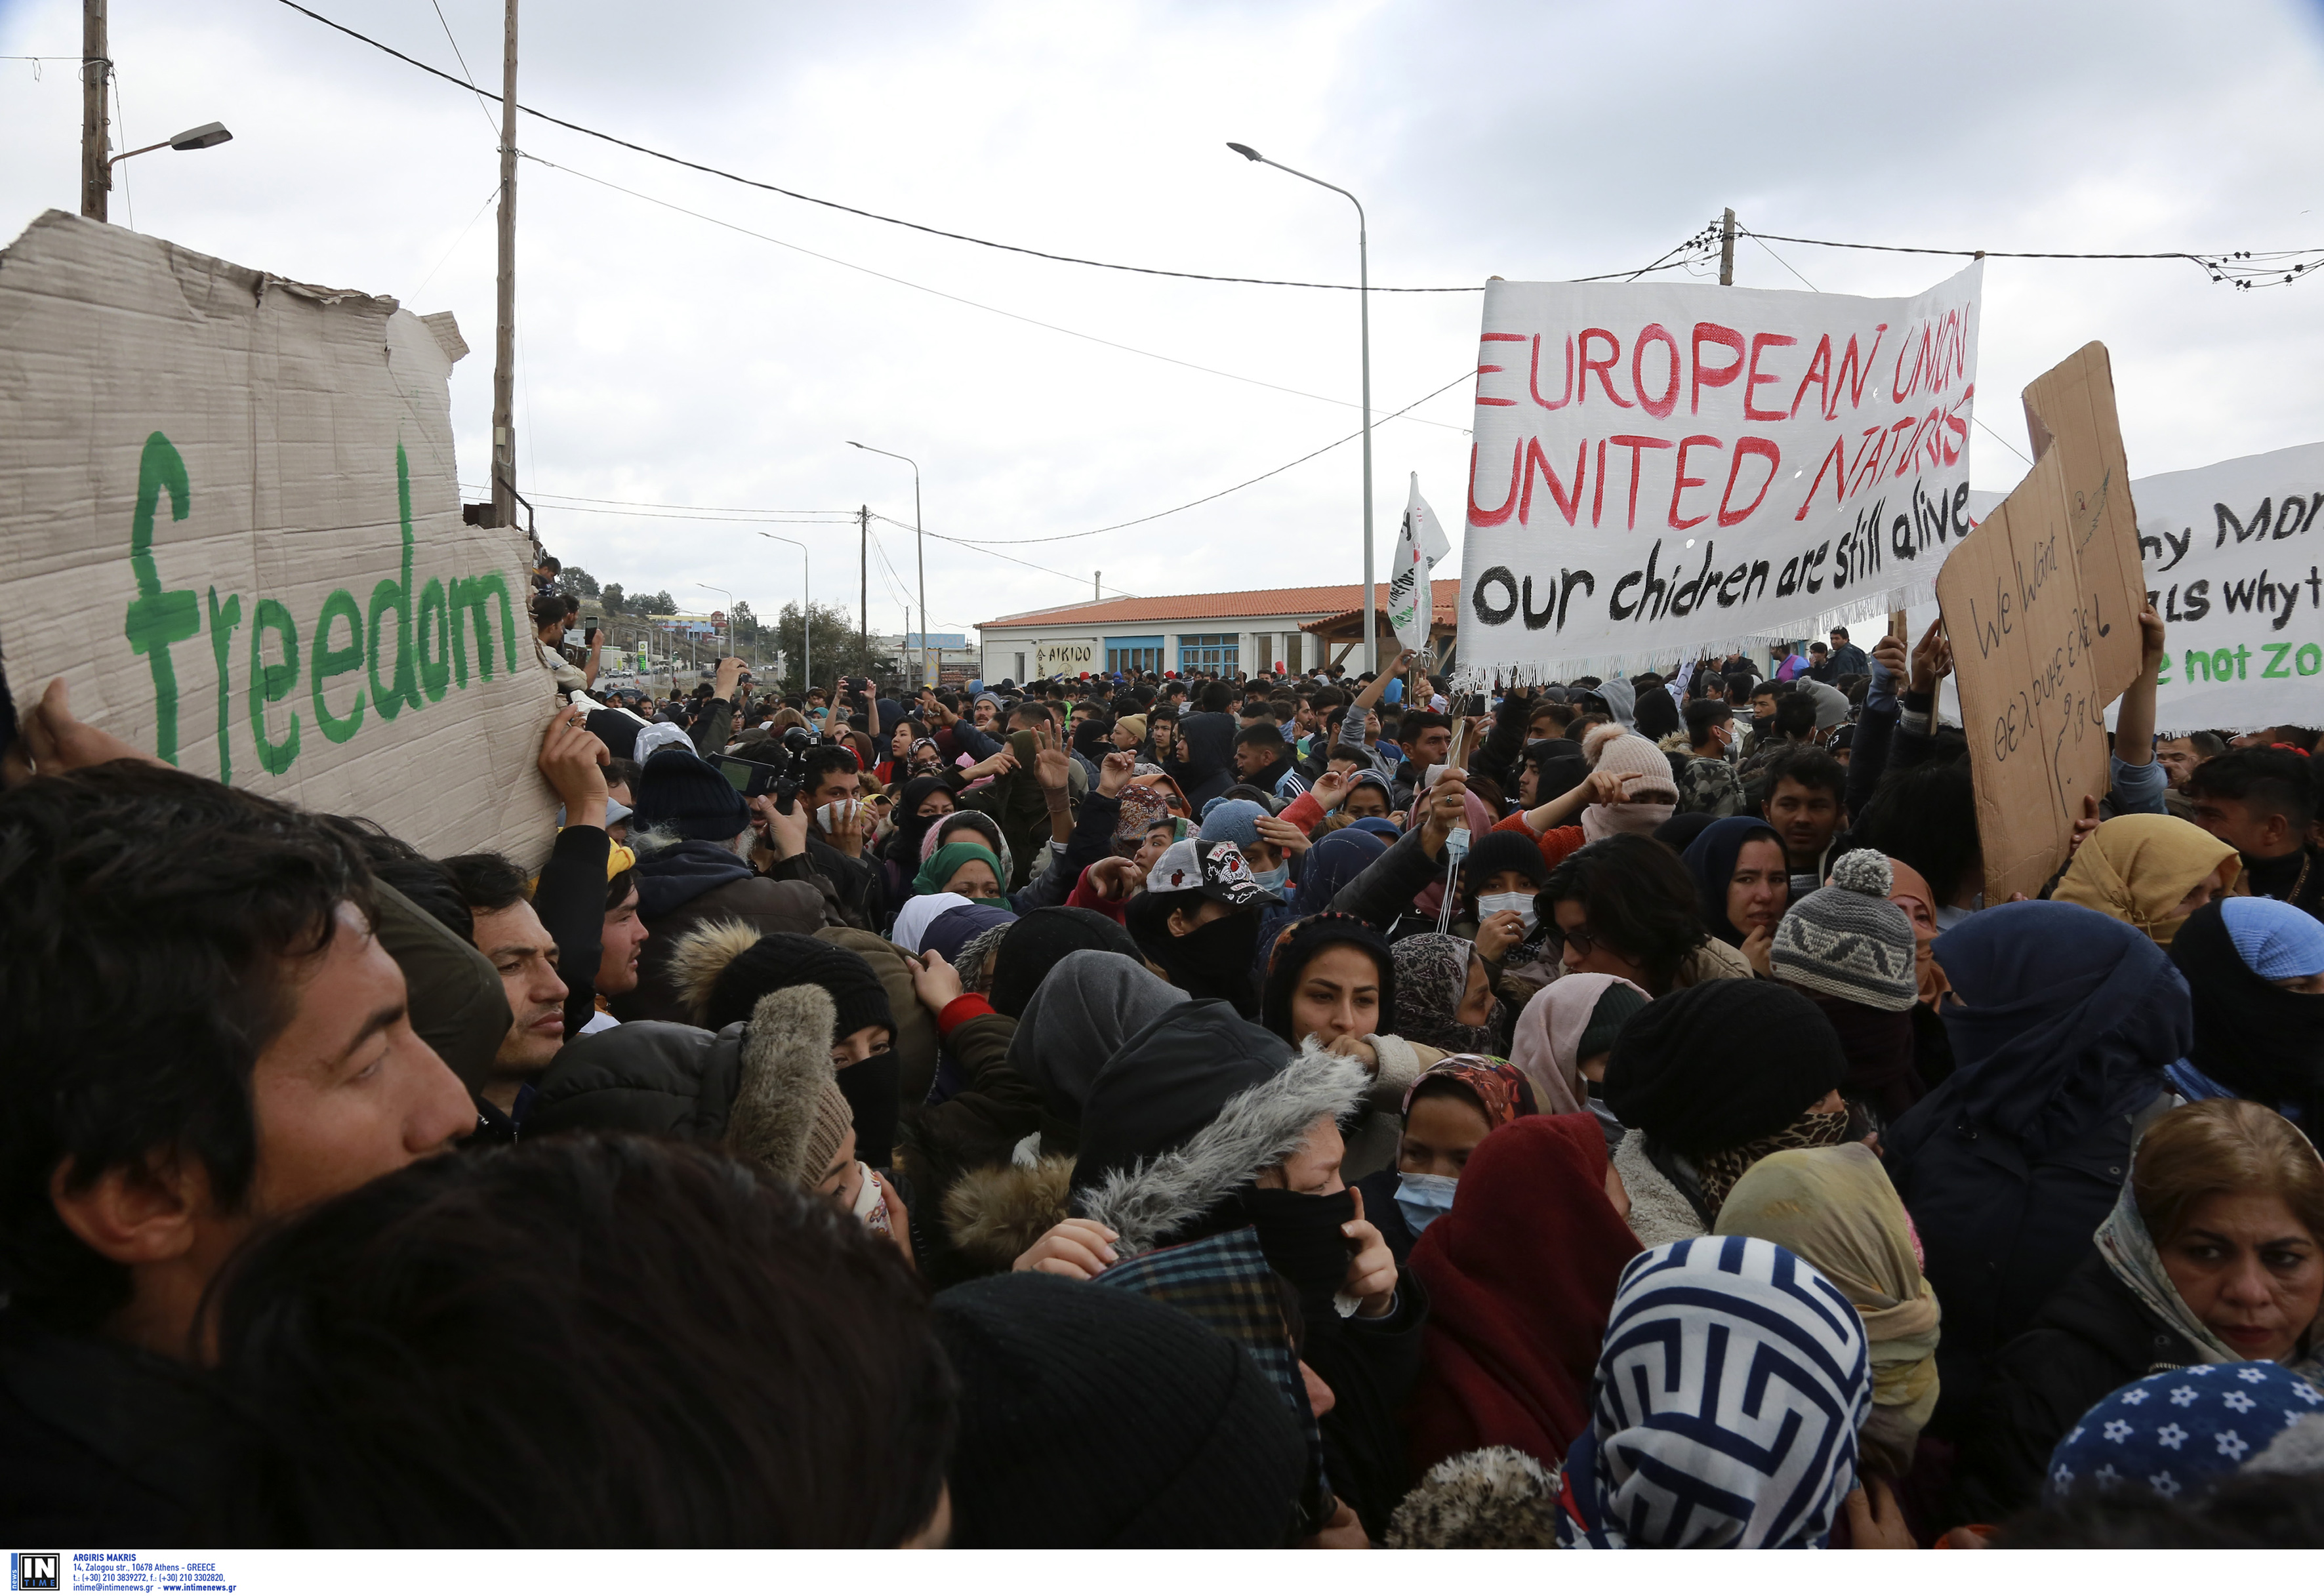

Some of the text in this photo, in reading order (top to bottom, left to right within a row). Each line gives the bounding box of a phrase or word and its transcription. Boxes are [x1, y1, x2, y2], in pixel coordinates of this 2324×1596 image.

[1477, 300, 1970, 421] EUROPEAN UNION
[1467, 434, 1781, 531] UNITED
[1473, 565, 1595, 636] our
[1609, 538, 1770, 624] chidren
[1776, 539, 1830, 598] are
[1833, 496, 1886, 590] still
[1892, 476, 1969, 561] alive
[126, 431, 518, 786] freedom
[1049, 646, 1091, 662] AIKIDO
[1970, 576, 2012, 660] We
[2186, 644, 2253, 684] not
